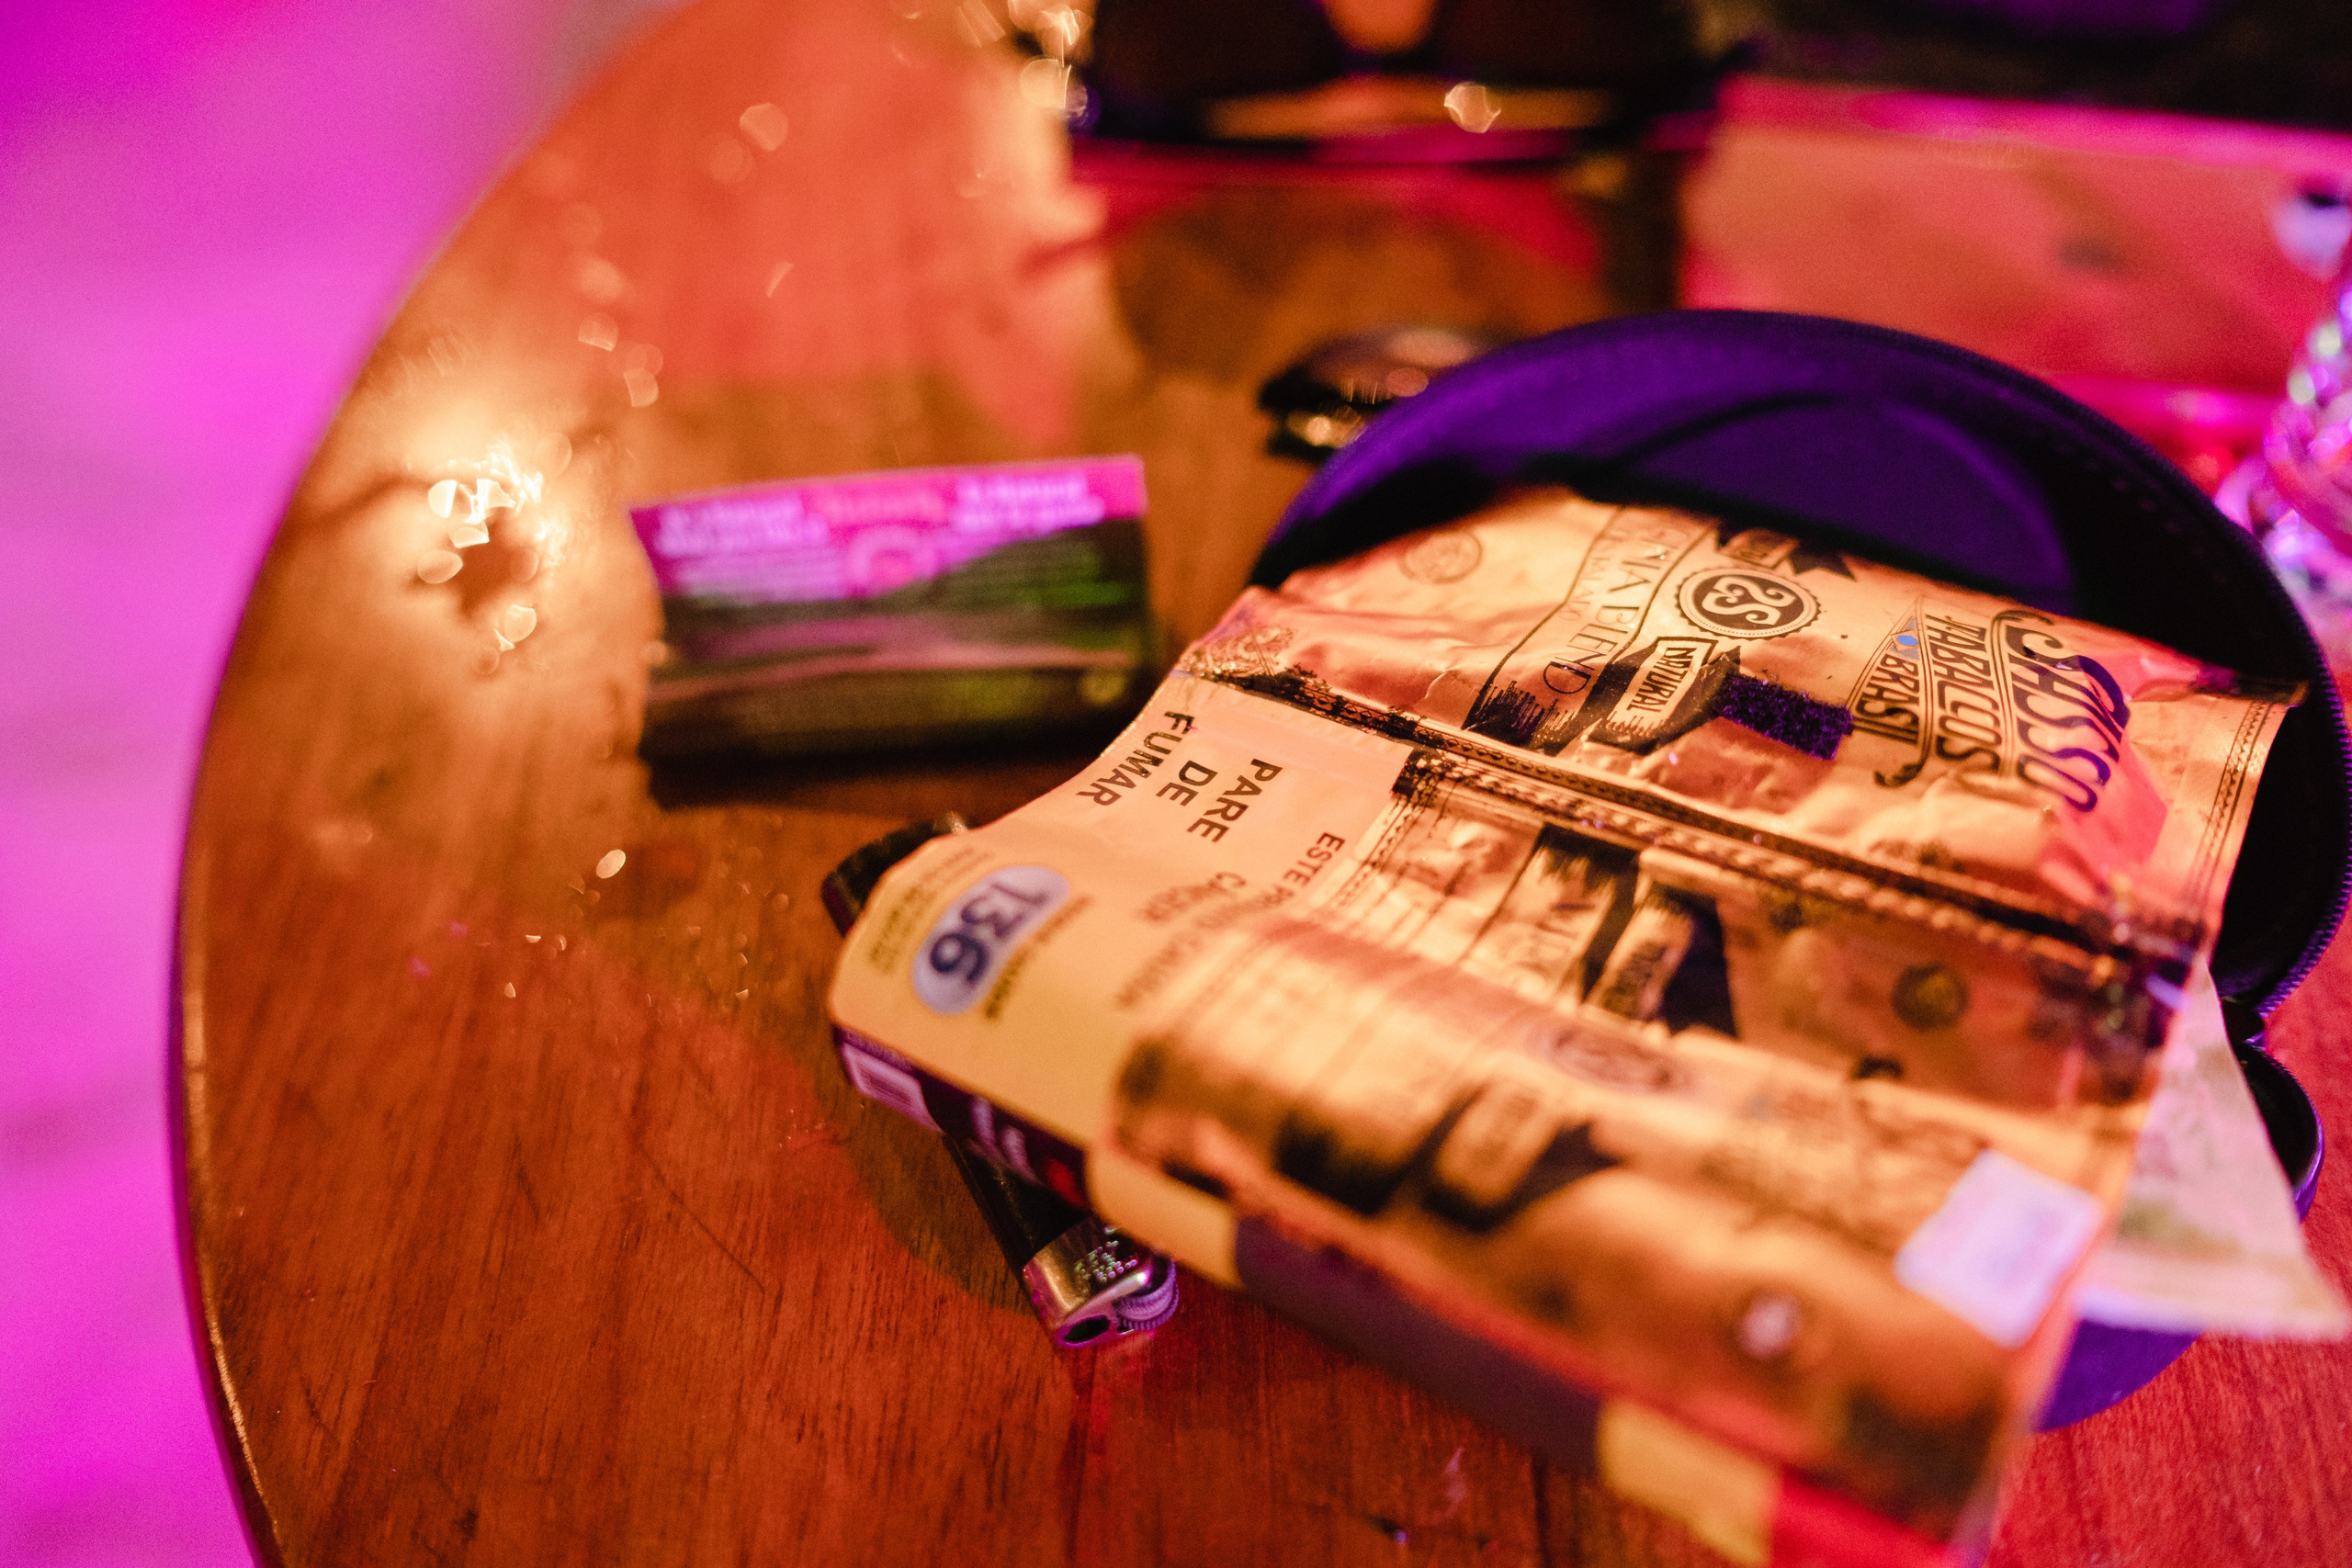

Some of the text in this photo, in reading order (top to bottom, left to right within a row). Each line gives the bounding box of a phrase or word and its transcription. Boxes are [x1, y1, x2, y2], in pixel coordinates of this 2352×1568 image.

[1544, 605, 1640, 694] BLEND
[1626, 647, 1698, 715] NATURAL
[1849, 655, 1922, 746] BRASIL
[2004, 623, 2131, 812] SASSO
[1076, 711, 1195, 807] FUMAR
[1156, 759, 1218, 807] DE
[1186, 758, 1283, 843] PARE
[1283, 831, 1346, 886] ESTE
[929, 880, 1049, 985] 136
